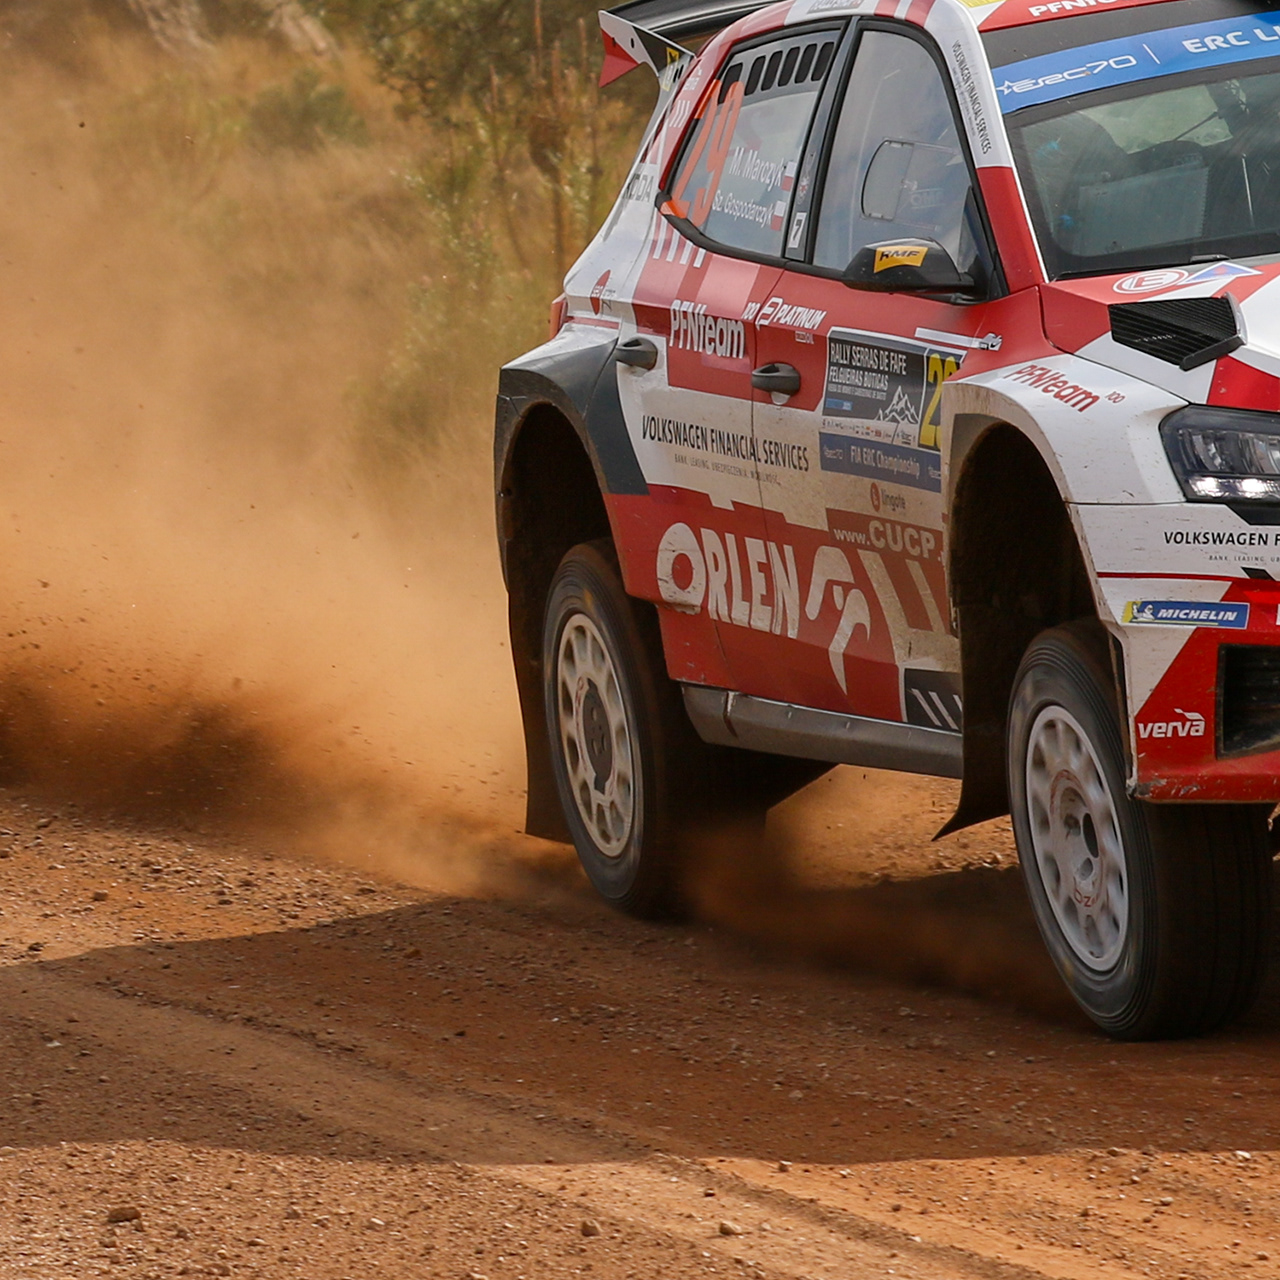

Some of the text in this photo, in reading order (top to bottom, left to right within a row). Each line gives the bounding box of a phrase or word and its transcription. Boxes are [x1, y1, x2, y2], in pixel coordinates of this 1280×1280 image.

[1181, 31, 1251, 55] ERC
[1010, 54, 1138, 94] ERC70
[952, 39, 973, 91] VOLKSWAGEN
[966, 79, 984, 122] FINANCIAL
[975, 117, 993, 155] SERVICES
[729, 146, 744, 176] M.
[743, 149, 785, 192] Marczyk
[724, 192, 774, 229] Gospodarczyk
[878, 250, 920, 262] RMF
[773, 303, 828, 331] PLATINUM
[830, 342, 907, 376] RALLY SERRAS DE FAFE
[828, 366, 889, 391] FELGUEIRAS BOTICAS
[641, 414, 810, 472] VOLKSWAGEN FINANCIAL SERVICES
[850, 445, 862, 464] FIA
[862, 446, 875, 467] ERC
[876, 450, 920, 480] Championship
[1164, 531, 1269, 546] VOLKSWAGEN
[656, 522, 800, 640] ORLEN
[1156, 608, 1238, 622] MICHELIN
[1137, 720, 1206, 739] verva
